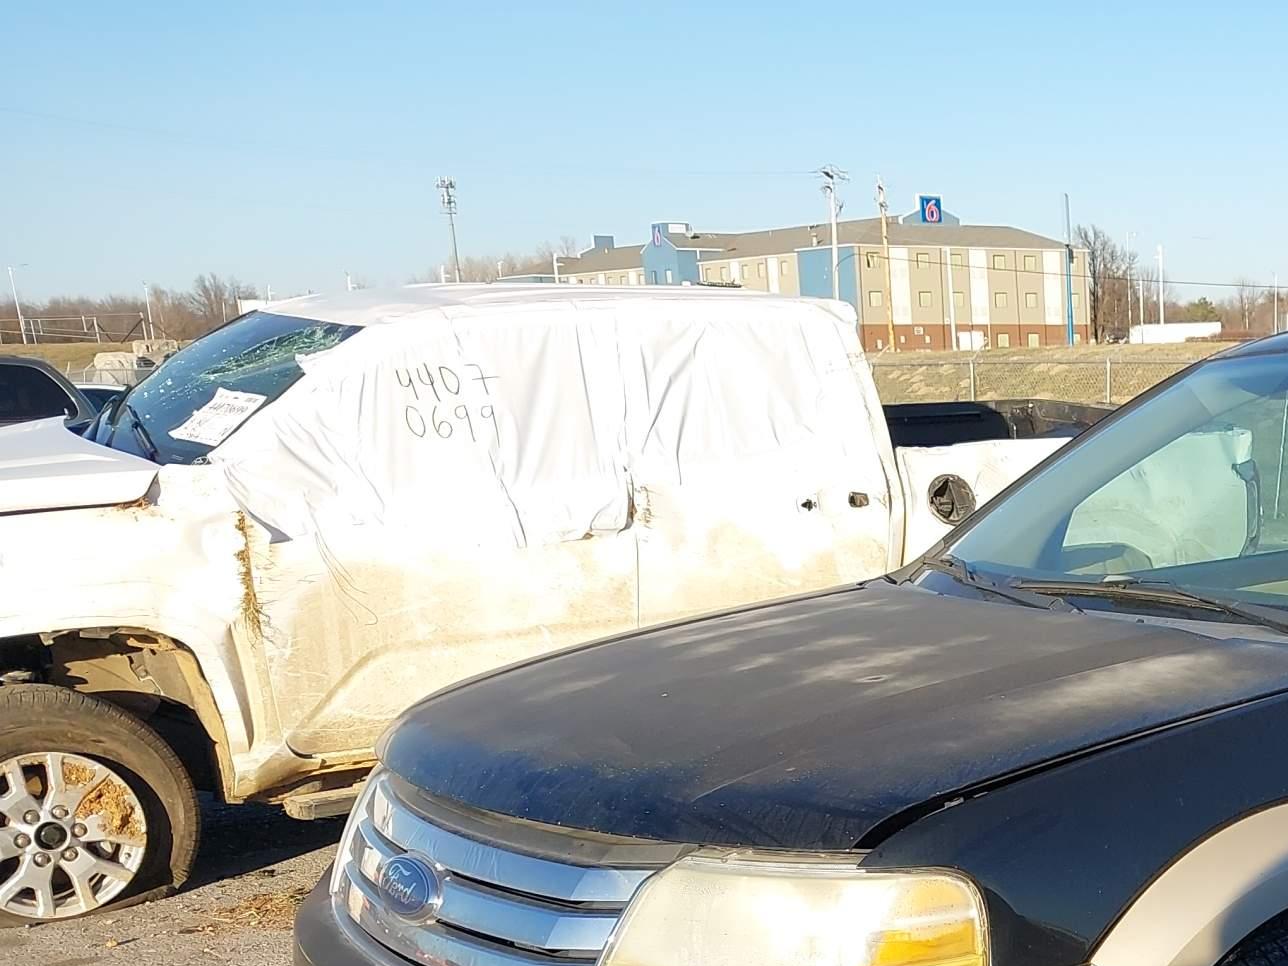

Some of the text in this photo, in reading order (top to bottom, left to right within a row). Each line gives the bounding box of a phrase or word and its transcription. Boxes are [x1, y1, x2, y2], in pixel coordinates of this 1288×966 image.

[926, 200, 939, 222] 6
[395, 362, 500, 402] 4407
[406, 404, 500, 448] 0699
[384, 863, 417, 902] Ford
